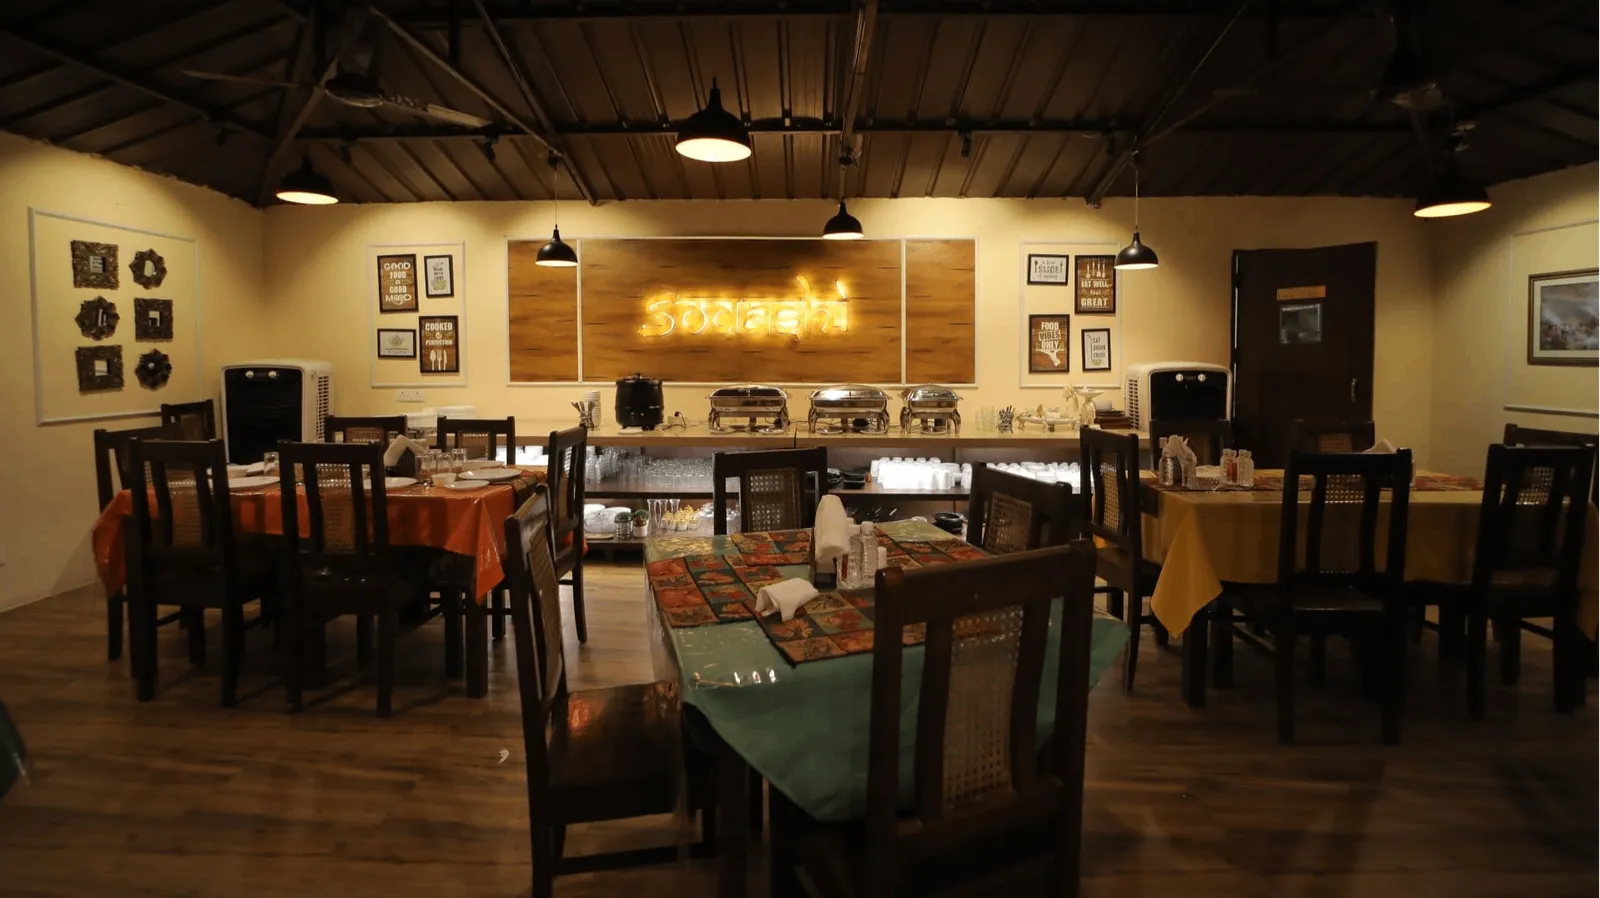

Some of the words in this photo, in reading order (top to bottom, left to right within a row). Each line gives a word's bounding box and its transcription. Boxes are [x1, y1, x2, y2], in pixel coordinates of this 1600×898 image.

[384, 262, 411, 270] GOOD
[390, 271, 407, 279] FOOD
[1081, 280, 1091, 288] EAT
[390, 285, 408, 293] GOOD
[385, 293, 412, 305] MOOD
[1081, 297, 1108, 307] GREAT
[425, 322, 453, 331] COOKED
[1041, 321, 1060, 330] FOOD
[1039, 330, 1061, 340] VIBES
[1041, 340, 1059, 349] ONLY
